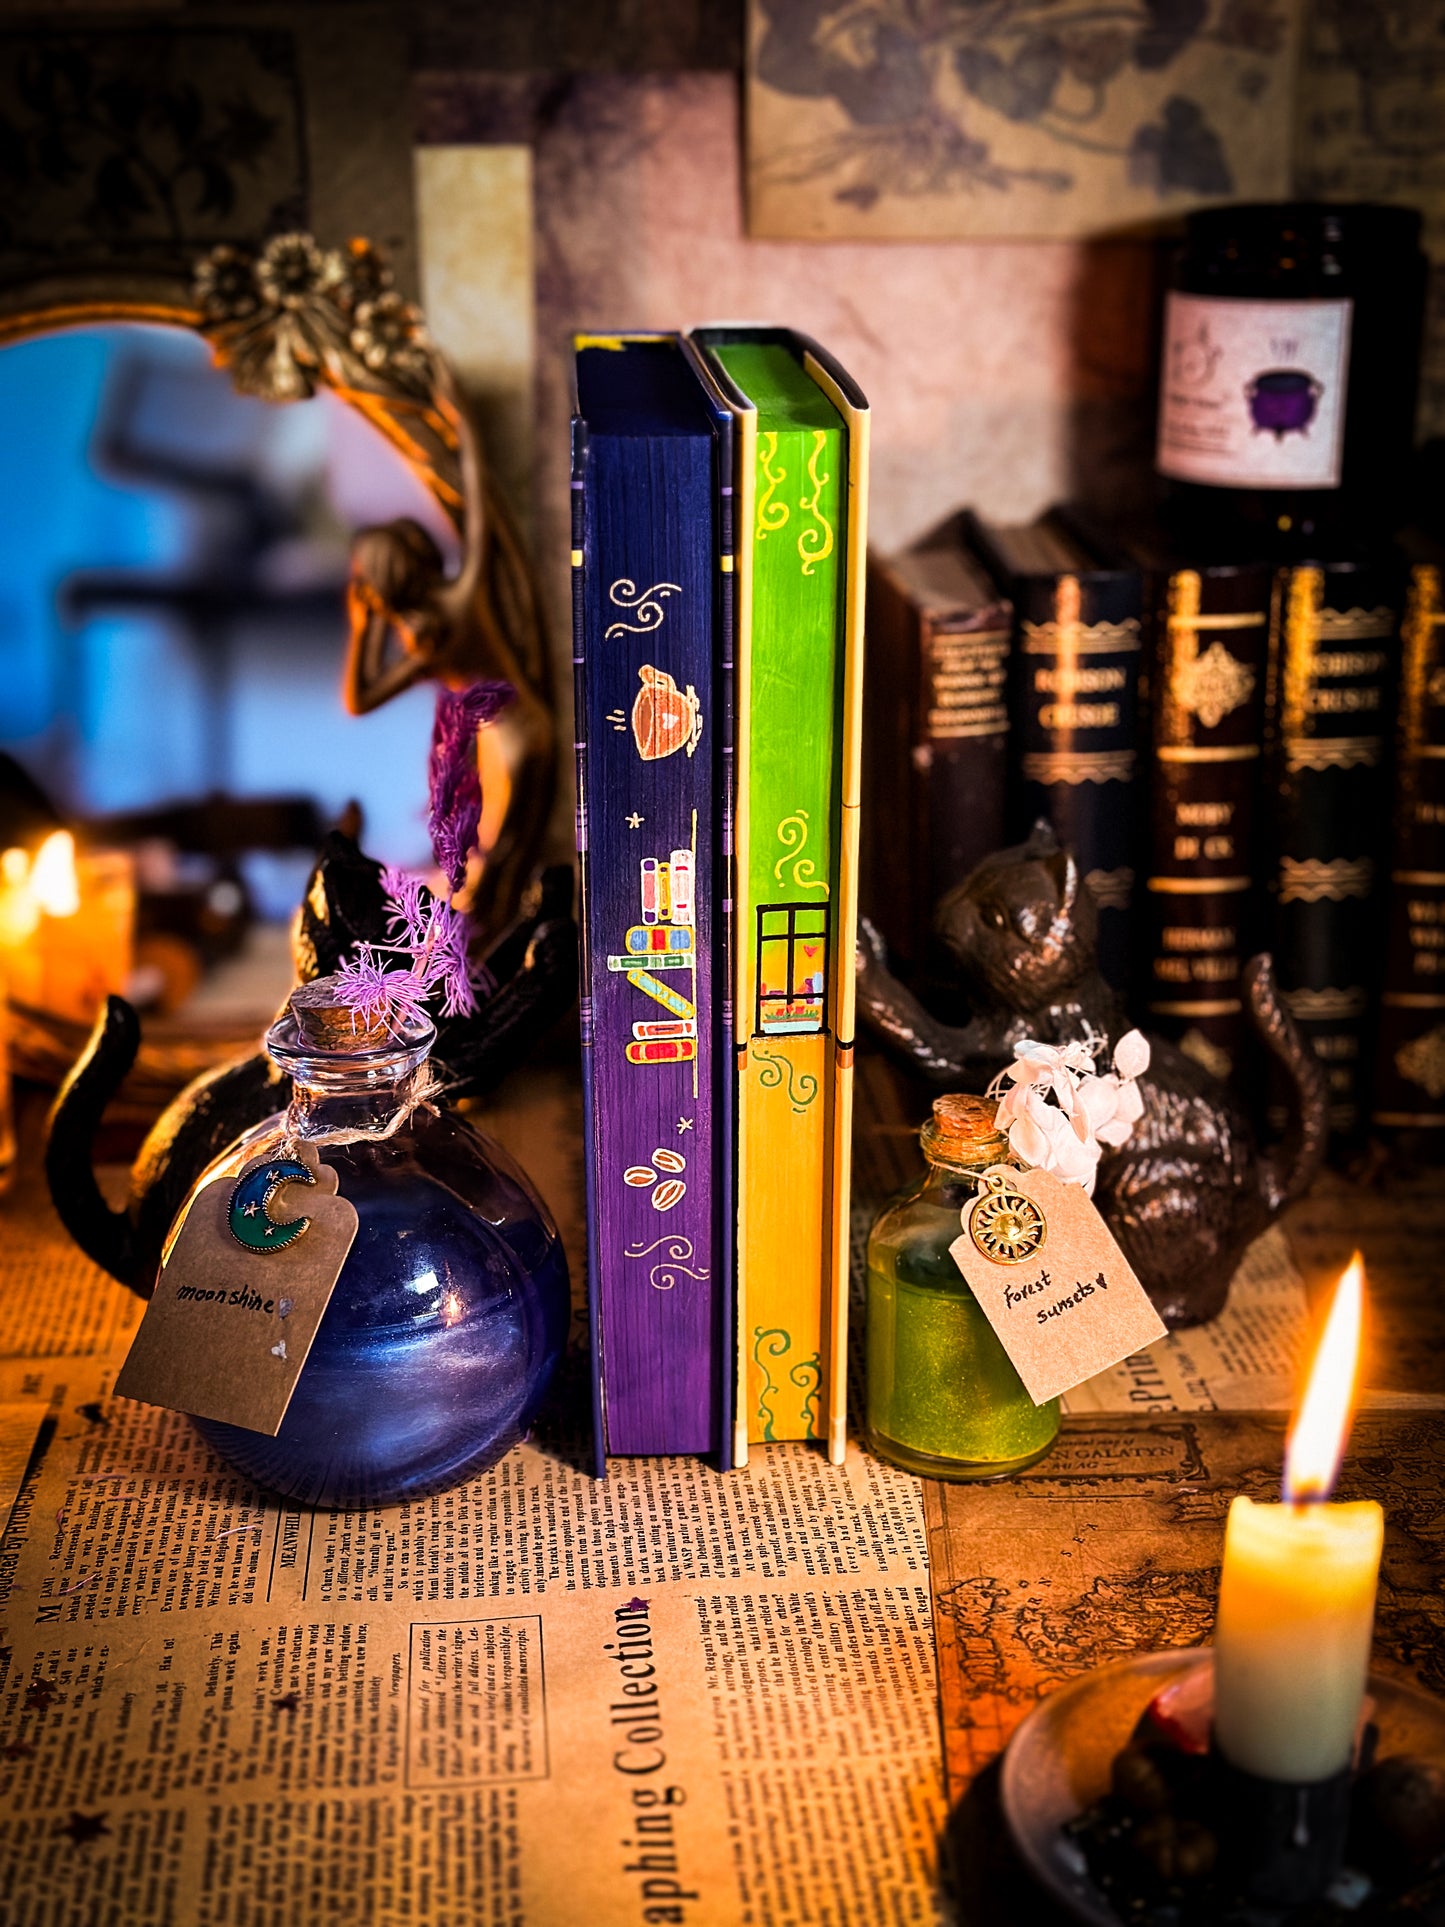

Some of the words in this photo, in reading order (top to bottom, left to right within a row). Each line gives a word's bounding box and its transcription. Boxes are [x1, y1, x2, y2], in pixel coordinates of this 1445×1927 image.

[544, 1500, 557, 1531] wonderful
[603, 1496, 614, 1516] Lauren
[676, 1500, 689, 1520] games
[328, 1524, 337, 1535] was
[605, 1519, 616, 1538] Ralph
[861, 1503, 879, 1538] acceptable.
[429, 1521, 441, 1541] racing
[488, 1523, 500, 1546] regular
[678, 1523, 693, 1544] parlor
[0, 1537, 28, 1550] by
[171, 1544, 182, 1554] the
[607, 1542, 618, 1552] for
[871, 1540, 886, 1564] socially
[182, 1546, 198, 1568] history
[232, 1544, 244, 1564] known
[324, 1545, 335, 1563] where
[386, 1554, 394, 1566] was
[488, 1556, 499, 1568] like
[548, 1547, 558, 1564] track
[681, 1547, 694, 1569] WASP
[906, 1557, 917, 1570] one
[168, 1570, 178, 1582] one
[231, 1567, 240, 1578] was
[321, 1567, 334, 1591] Church,
[549, 1567, 559, 1580] The
[609, 1555, 621, 1587] tisements
[700, 1563, 710, 1578] That
[178, 1572, 194, 1610] newspaper
[244, 1577, 256, 1589] this
[383, 1576, 394, 1588] that
[428, 1578, 439, 1600] Miami
[488, 1571, 501, 1596] looking
[160, 1586, 176, 1612] Evans,
[242, 1593, 253, 1604] did
[895, 1587, 910, 1600] and
[131, 1595, 145, 1615] every
[710, 1595, 723, 1614] white
[714, 1620, 725, 1630] the
[903, 1605, 918, 1631] makers
[277, 1626, 287, 1645] came
[307, 1625, 319, 1644] world
[323, 1624, 335, 1645] friend
[468, 1627, 479, 1641] Let-
[716, 1633, 729, 1646] and
[780, 1626, 791, 1636] for
[210, 1633, 223, 1650] This
[291, 1625, 303, 1662] reluctant-
[420, 1630, 431, 1671] publication
[485, 1633, 496, 1659] subject
[307, 1648, 317, 1659] the
[324, 1649, 333, 1663] new
[502, 1638, 514, 1680] responsible
[701, 1637, 717, 1671] Reagan's
[912, 1636, 931, 1674] horoscope
[48, 1660, 59, 1674] and
[291, 1665, 300, 1673] to
[307, 1662, 316, 1670] to
[339, 1655, 351, 1681] betting
[784, 1639, 804, 1696] pseudoscience
[603, 1606, 667, 1776] Collection
